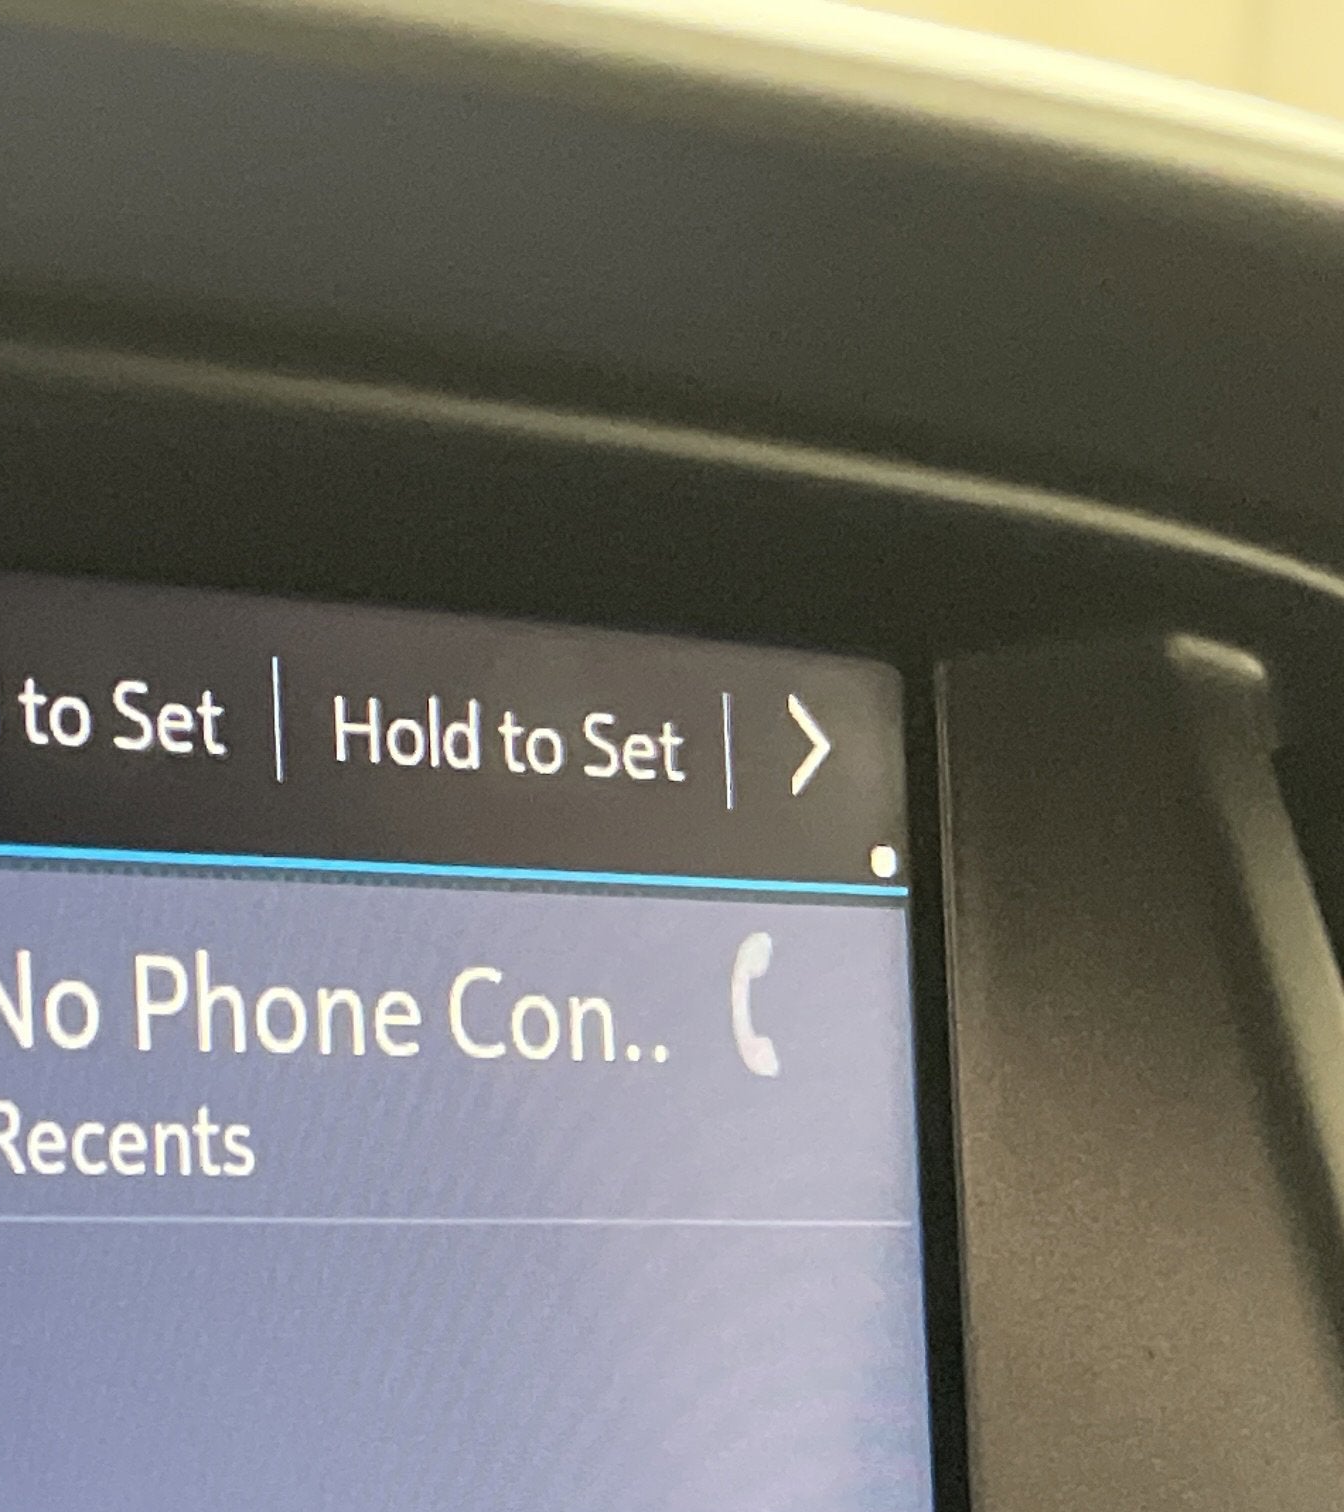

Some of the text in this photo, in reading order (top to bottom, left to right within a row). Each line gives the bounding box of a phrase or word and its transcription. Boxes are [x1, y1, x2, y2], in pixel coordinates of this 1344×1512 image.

[16, 676, 92, 748] to
[111, 679, 228, 757] Set
[332, 694, 687, 783] Hold to Set
[134, 948, 423, 1058] Phone
